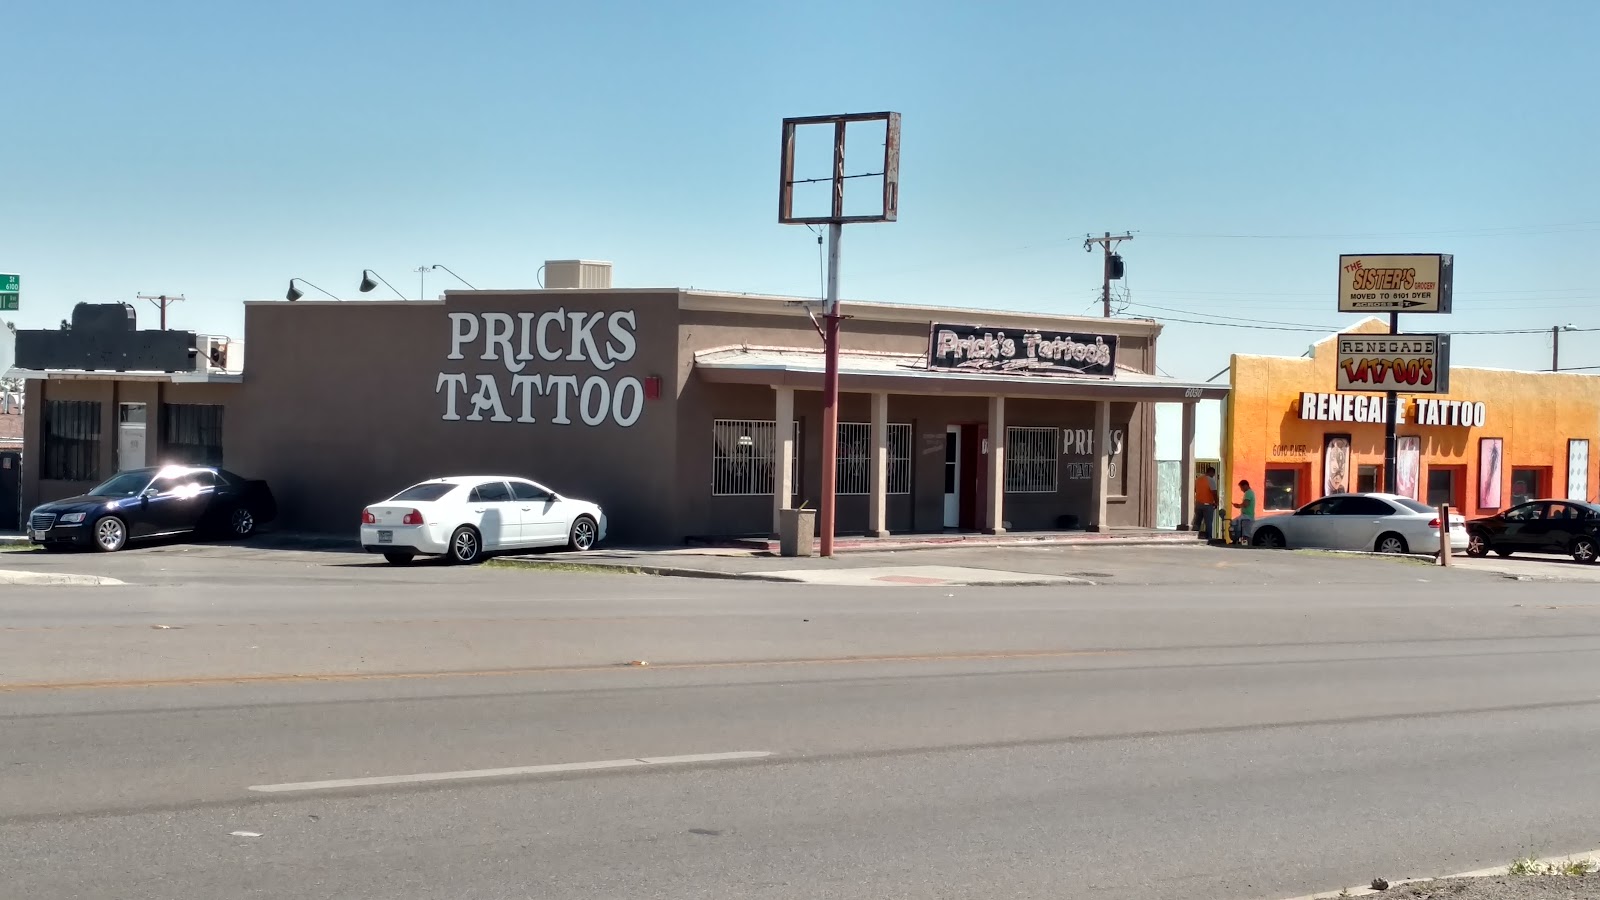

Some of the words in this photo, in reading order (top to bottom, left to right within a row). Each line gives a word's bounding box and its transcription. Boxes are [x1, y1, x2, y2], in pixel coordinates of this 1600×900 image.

[1344, 260, 1363, 274] THE
[1353, 267, 1416, 291] SISTER'S
[1414, 281, 1436, 290] GROCERY
[1380, 292, 1390, 300] TO
[447, 306, 637, 373] PRICKS
[937, 330, 1015, 359] Prick's
[1023, 333, 1111, 367] Tattoo's
[1342, 342, 1433, 353] RENEGADE
[1341, 357, 1433, 386] TATTOO'S
[435, 371, 645, 427] TATTOO
[1417, 398, 1486, 427] TATTOO
[1063, 429, 1123, 456] PRIKS
[1272, 444, 1288, 456] 6010
[1290, 444, 1306, 456] DYER
[1067, 462, 1117, 480] TATO
